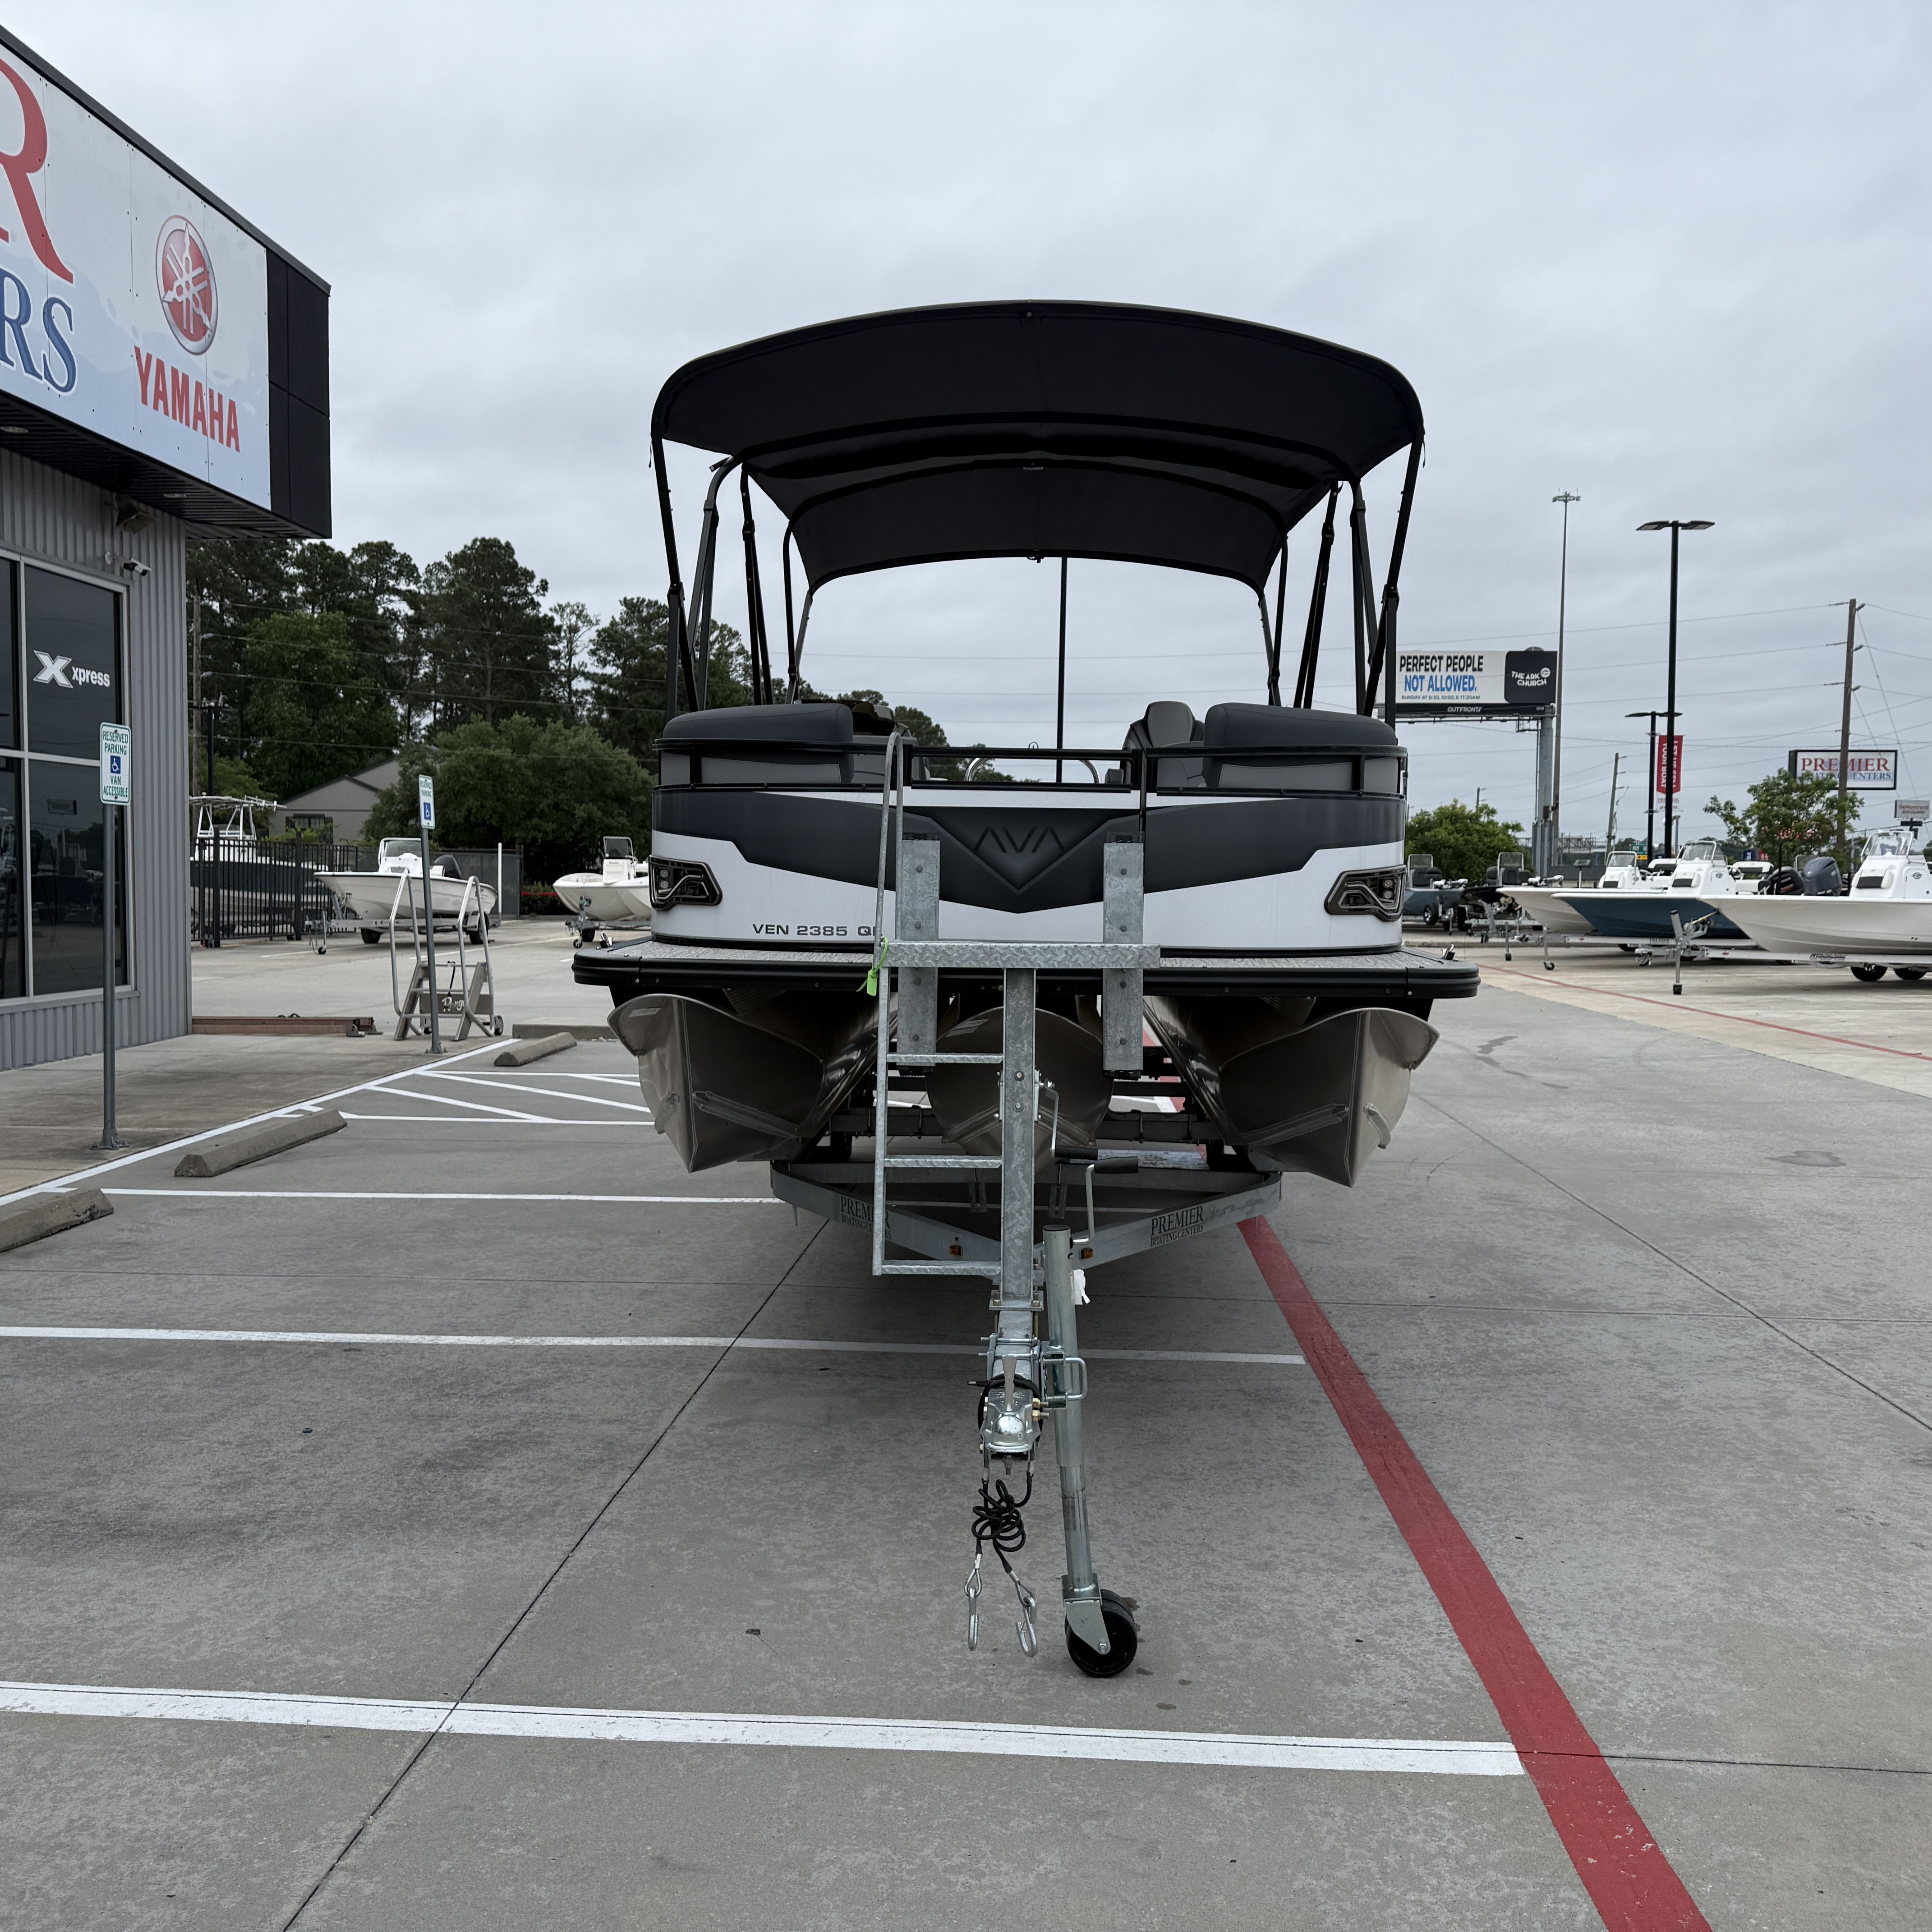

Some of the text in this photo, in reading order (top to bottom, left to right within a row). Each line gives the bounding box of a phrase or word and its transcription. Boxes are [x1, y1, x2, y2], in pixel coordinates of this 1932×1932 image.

[133, 345, 240, 453] YAMAHA
[1399, 655, 1484, 672] PERFECT PEOPLE
[72, 666, 110, 687] xpress
[1512, 671, 1525, 679] THE
[1404, 675, 1477, 692] NOT ALLOWED.
[1517, 678, 1547, 686] CHURCH
[103, 731, 128, 743] RESERVED
[105, 743, 127, 755] PARKING
[110, 775, 121, 786] VAN
[103, 786, 128, 797] ACCESSIBLE
[753, 924, 789, 935] VEN
[797, 925, 847, 936] 2385
[1151, 1205, 1204, 1236] PREMIER
[1150, 1223, 1204, 1247] BOATING CENTERS
